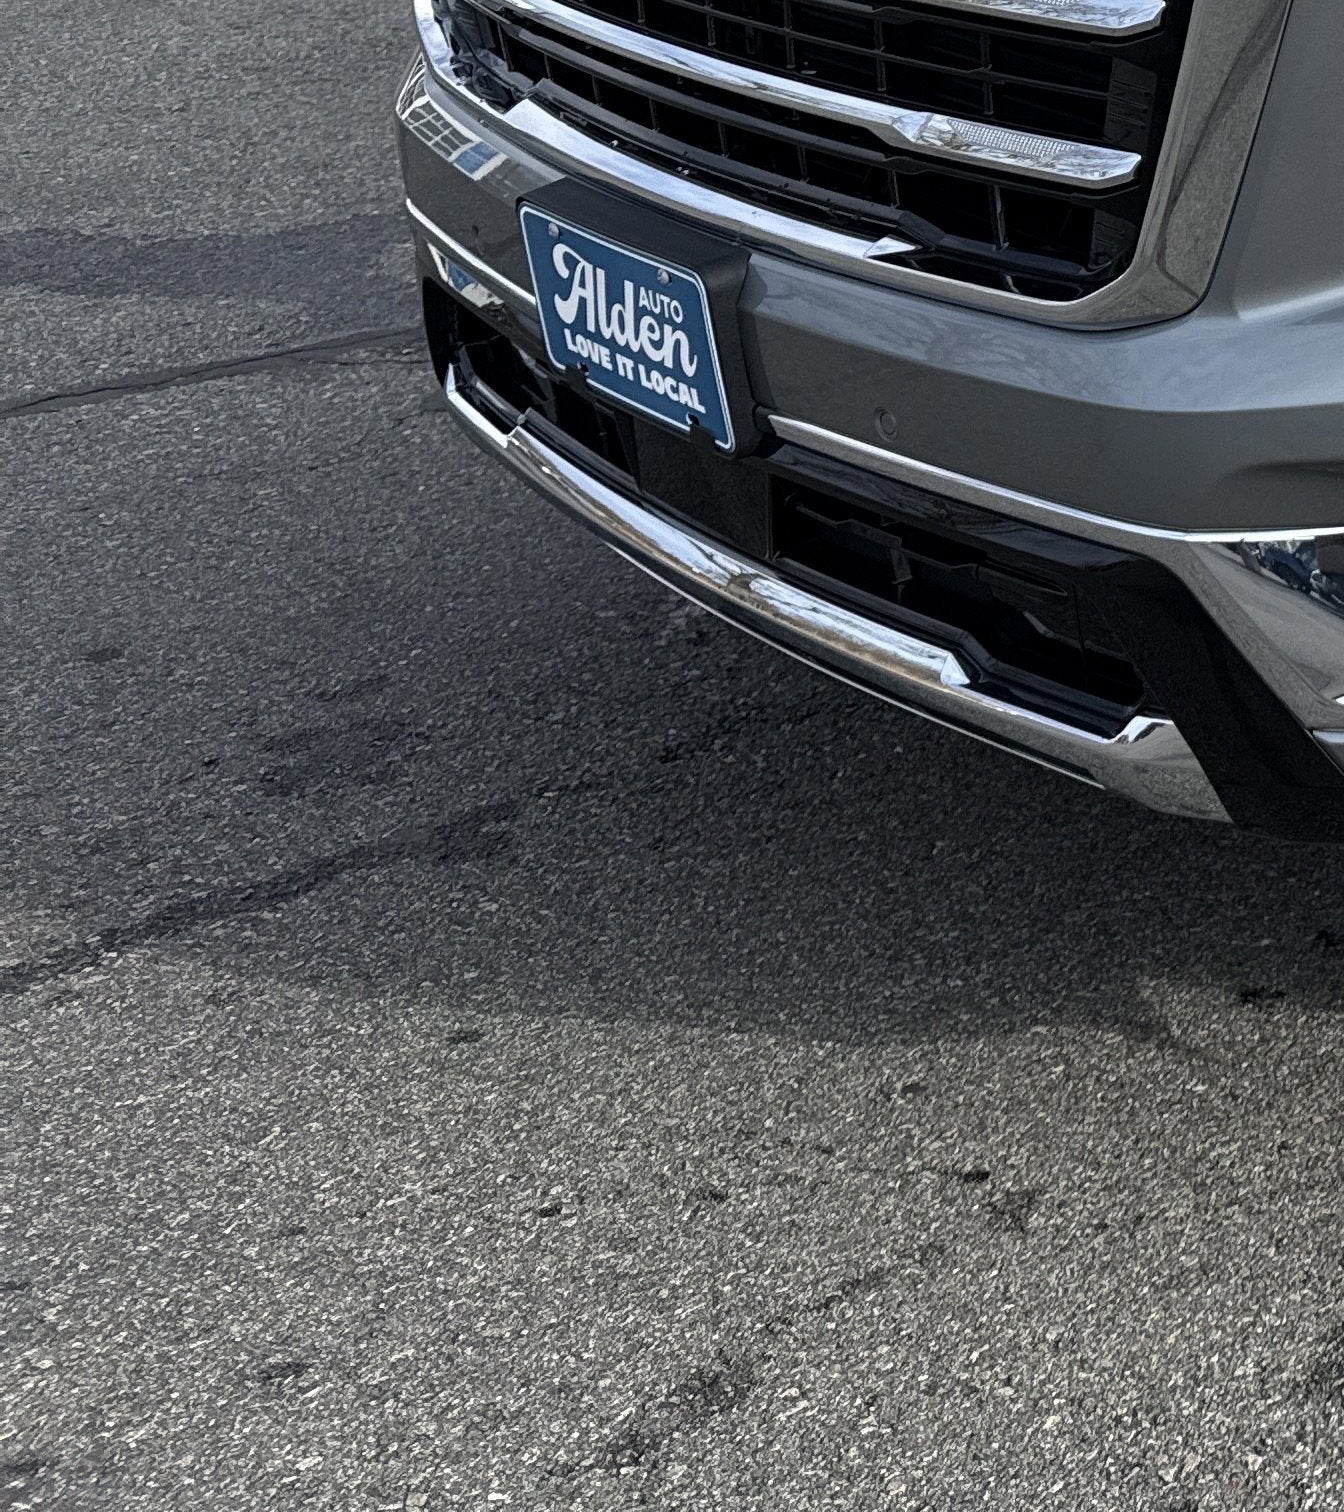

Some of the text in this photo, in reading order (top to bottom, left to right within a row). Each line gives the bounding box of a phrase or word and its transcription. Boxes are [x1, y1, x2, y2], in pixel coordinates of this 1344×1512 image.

[552, 243, 698, 377] Alden
[638, 286, 683, 324] AUTO
[563, 329, 707, 414] LOVE IT LOCAL
